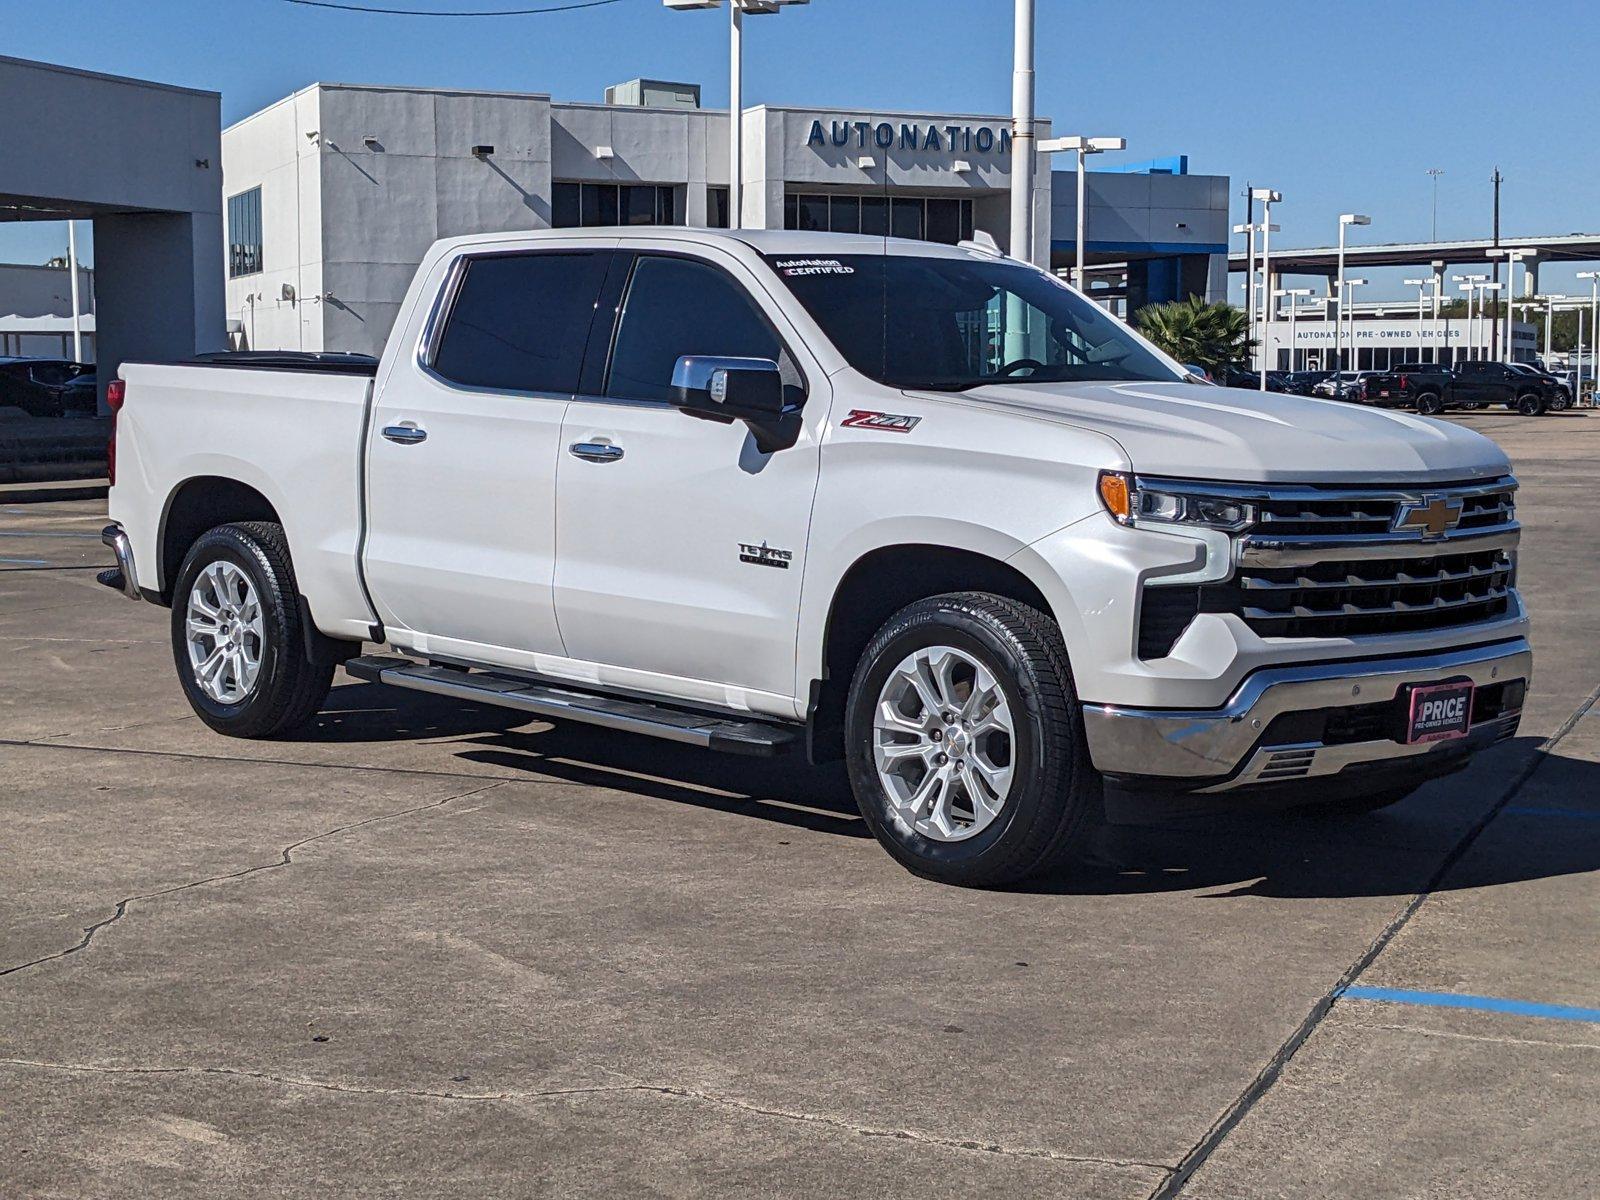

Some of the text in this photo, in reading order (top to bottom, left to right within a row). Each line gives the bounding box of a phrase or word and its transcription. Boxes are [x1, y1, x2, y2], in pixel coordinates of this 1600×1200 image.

[807, 119, 1012, 153] AUTONATION
[776, 260, 840, 268] AutoNation
[788, 266, 855, 276] CERTIFIED
[1297, 331, 1350, 339] AUTONATON
[1356, 330, 1412, 338] PRE-OWNED
[840, 409, 922, 433] Z71
